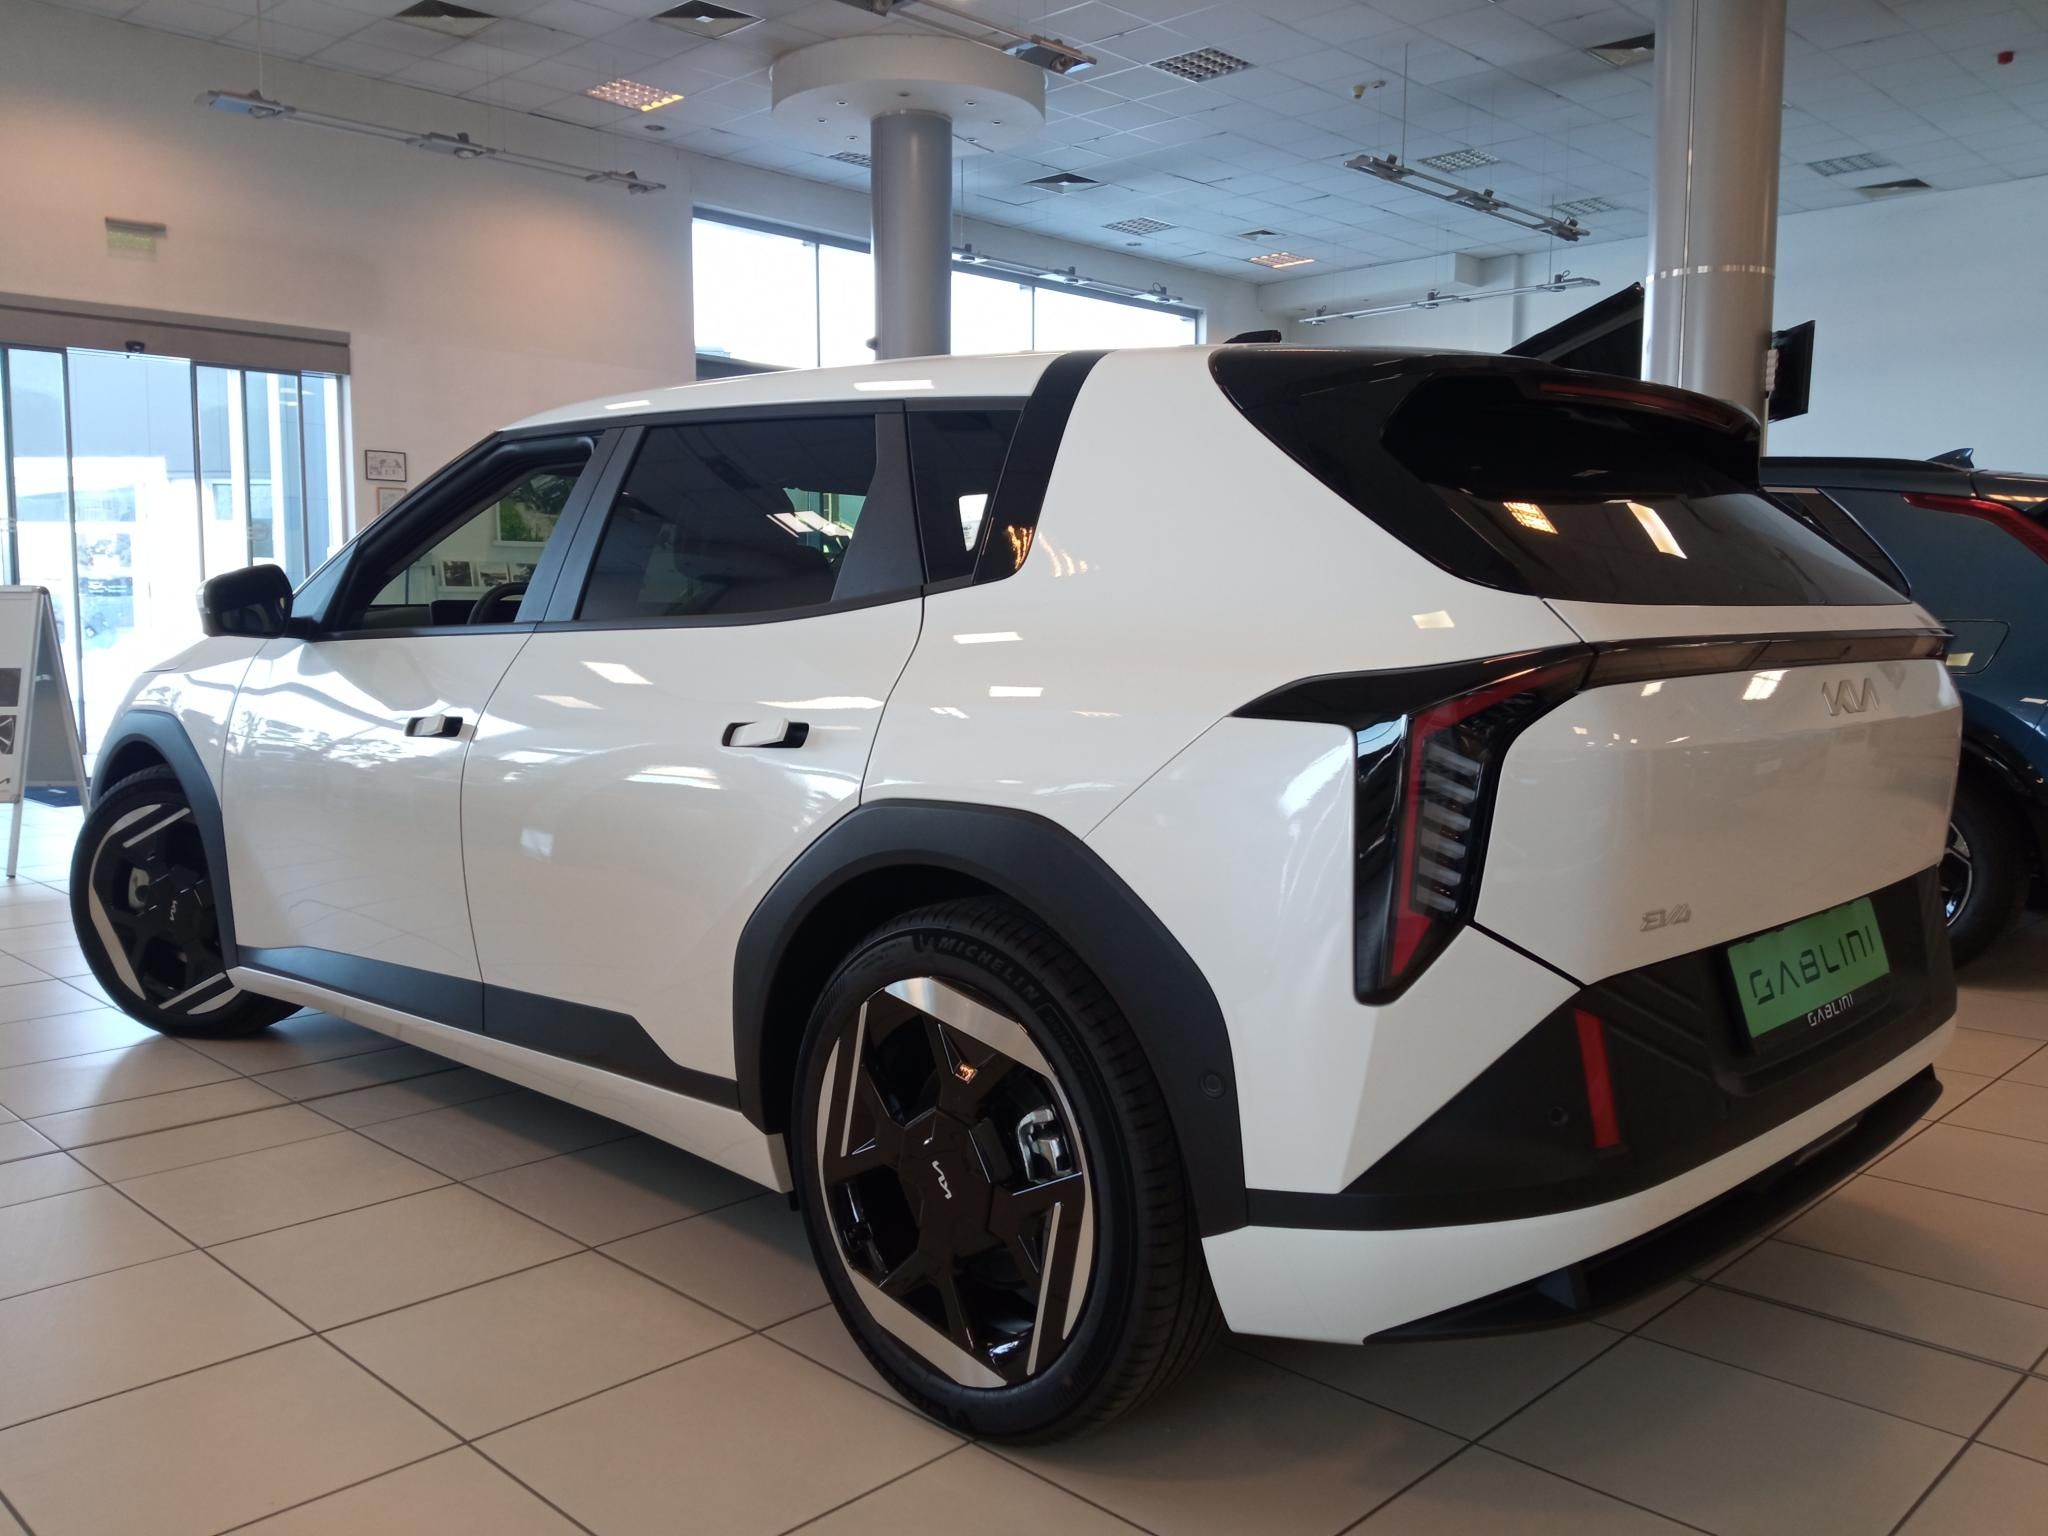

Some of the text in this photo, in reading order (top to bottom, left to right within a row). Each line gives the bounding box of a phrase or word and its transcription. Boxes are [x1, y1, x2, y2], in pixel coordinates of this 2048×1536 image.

[937, 936, 1041, 1001] MICHELIN
[1749, 925, 1875, 1006] GABLINI
[1807, 993, 1856, 1028] GABLINI
